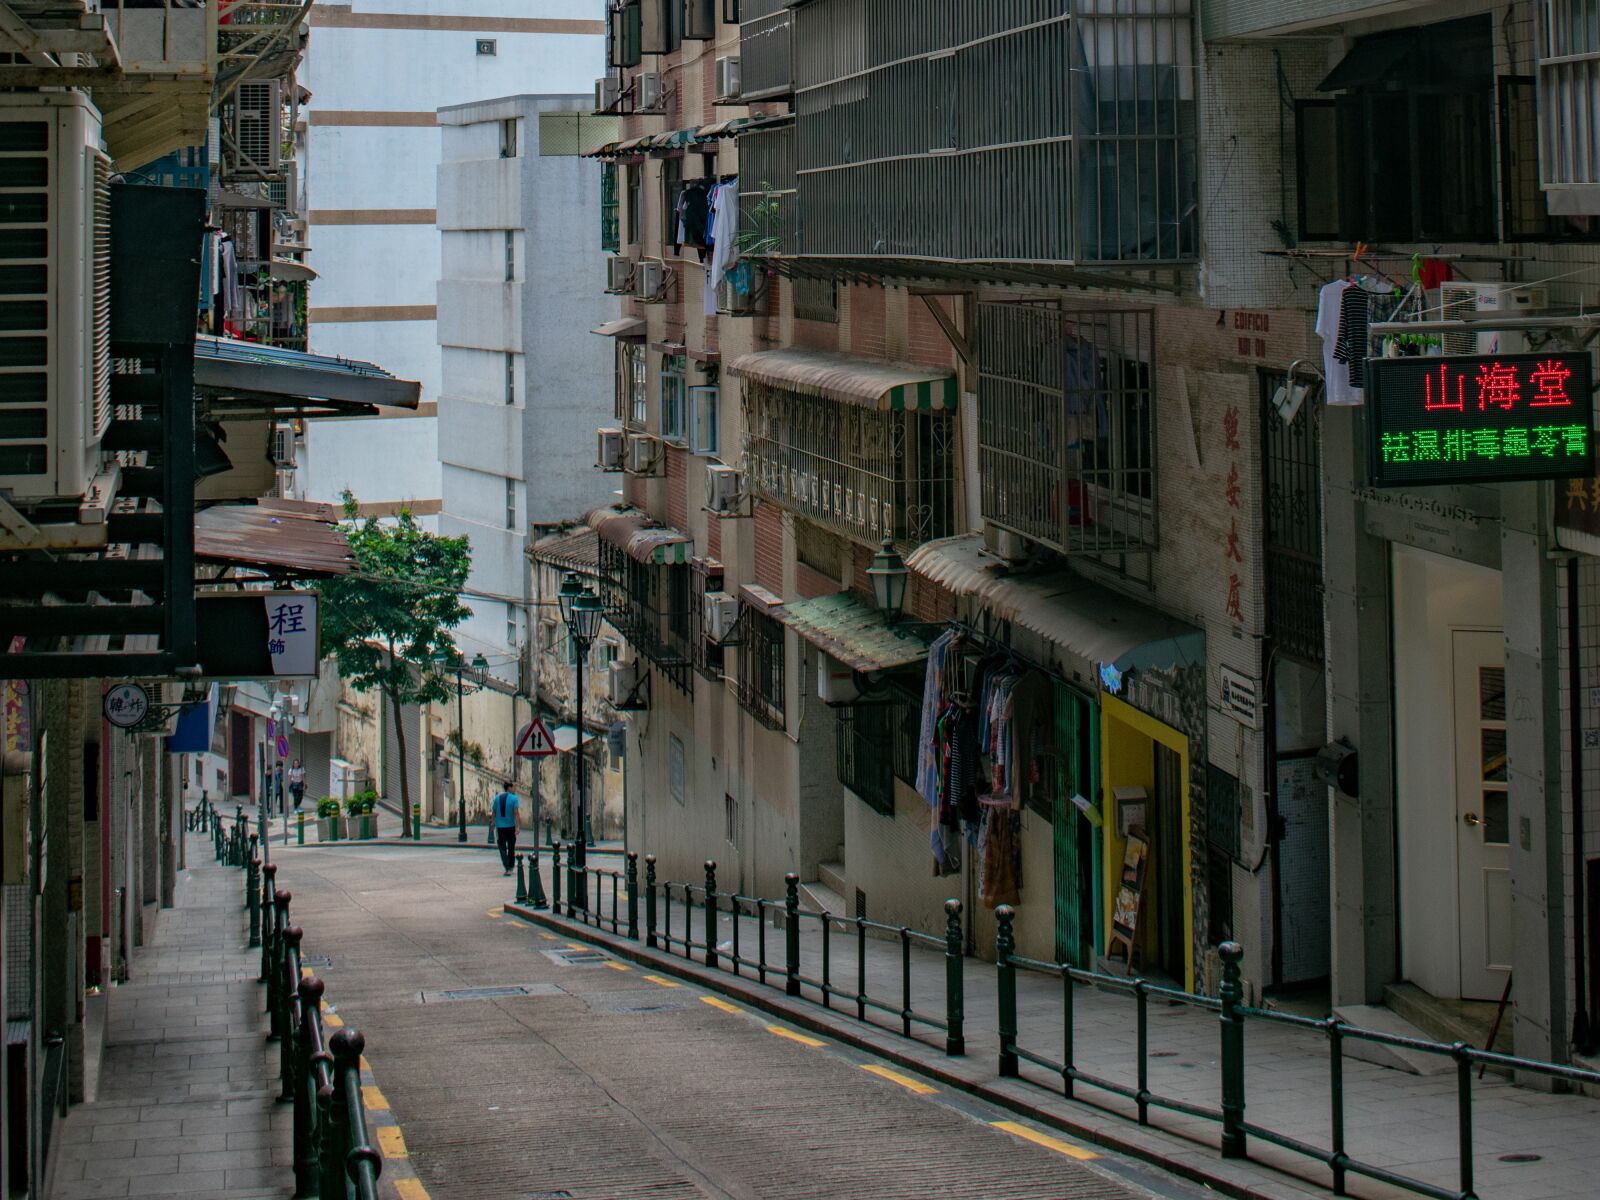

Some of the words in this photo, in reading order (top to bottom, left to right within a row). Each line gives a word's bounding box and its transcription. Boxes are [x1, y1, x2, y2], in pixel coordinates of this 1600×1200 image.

[1234, 311, 1270, 332] EDIFICIO
[1424, 358, 1574, 413] 山海堂
[1380, 423, 1588, 463] 祛濕排毒龜苓膏
[269, 603, 307, 636] 程
[268, 639, 286, 655] 飾
